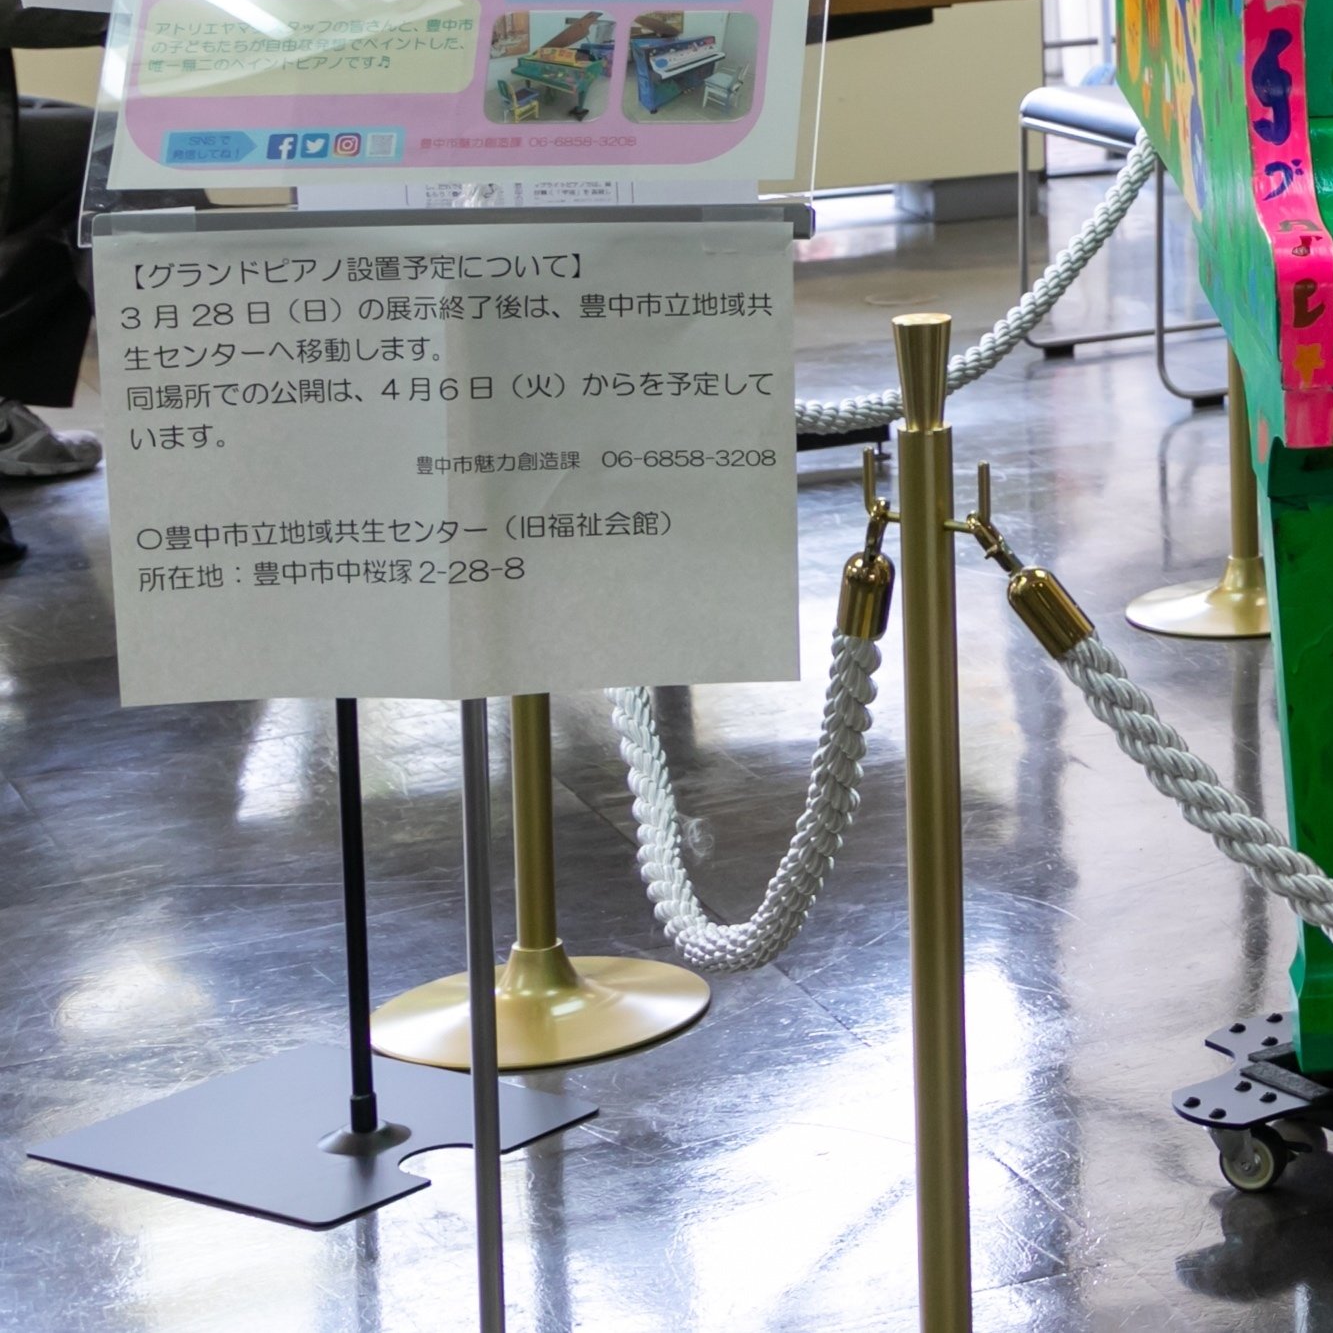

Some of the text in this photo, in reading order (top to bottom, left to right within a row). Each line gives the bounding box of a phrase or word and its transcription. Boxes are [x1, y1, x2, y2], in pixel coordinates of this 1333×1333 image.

[419, 136, 637, 150] 豊中市魅力創造課 06-6858-3208
[134, 252, 583, 291] 【グランドピアノ設置予定について】
[123, 336, 441, 371] 生センターへ移動します。
[130, 424, 226, 450] います。
[416, 449, 777, 476] 豊中市魅力創造課 06-6858-3208
